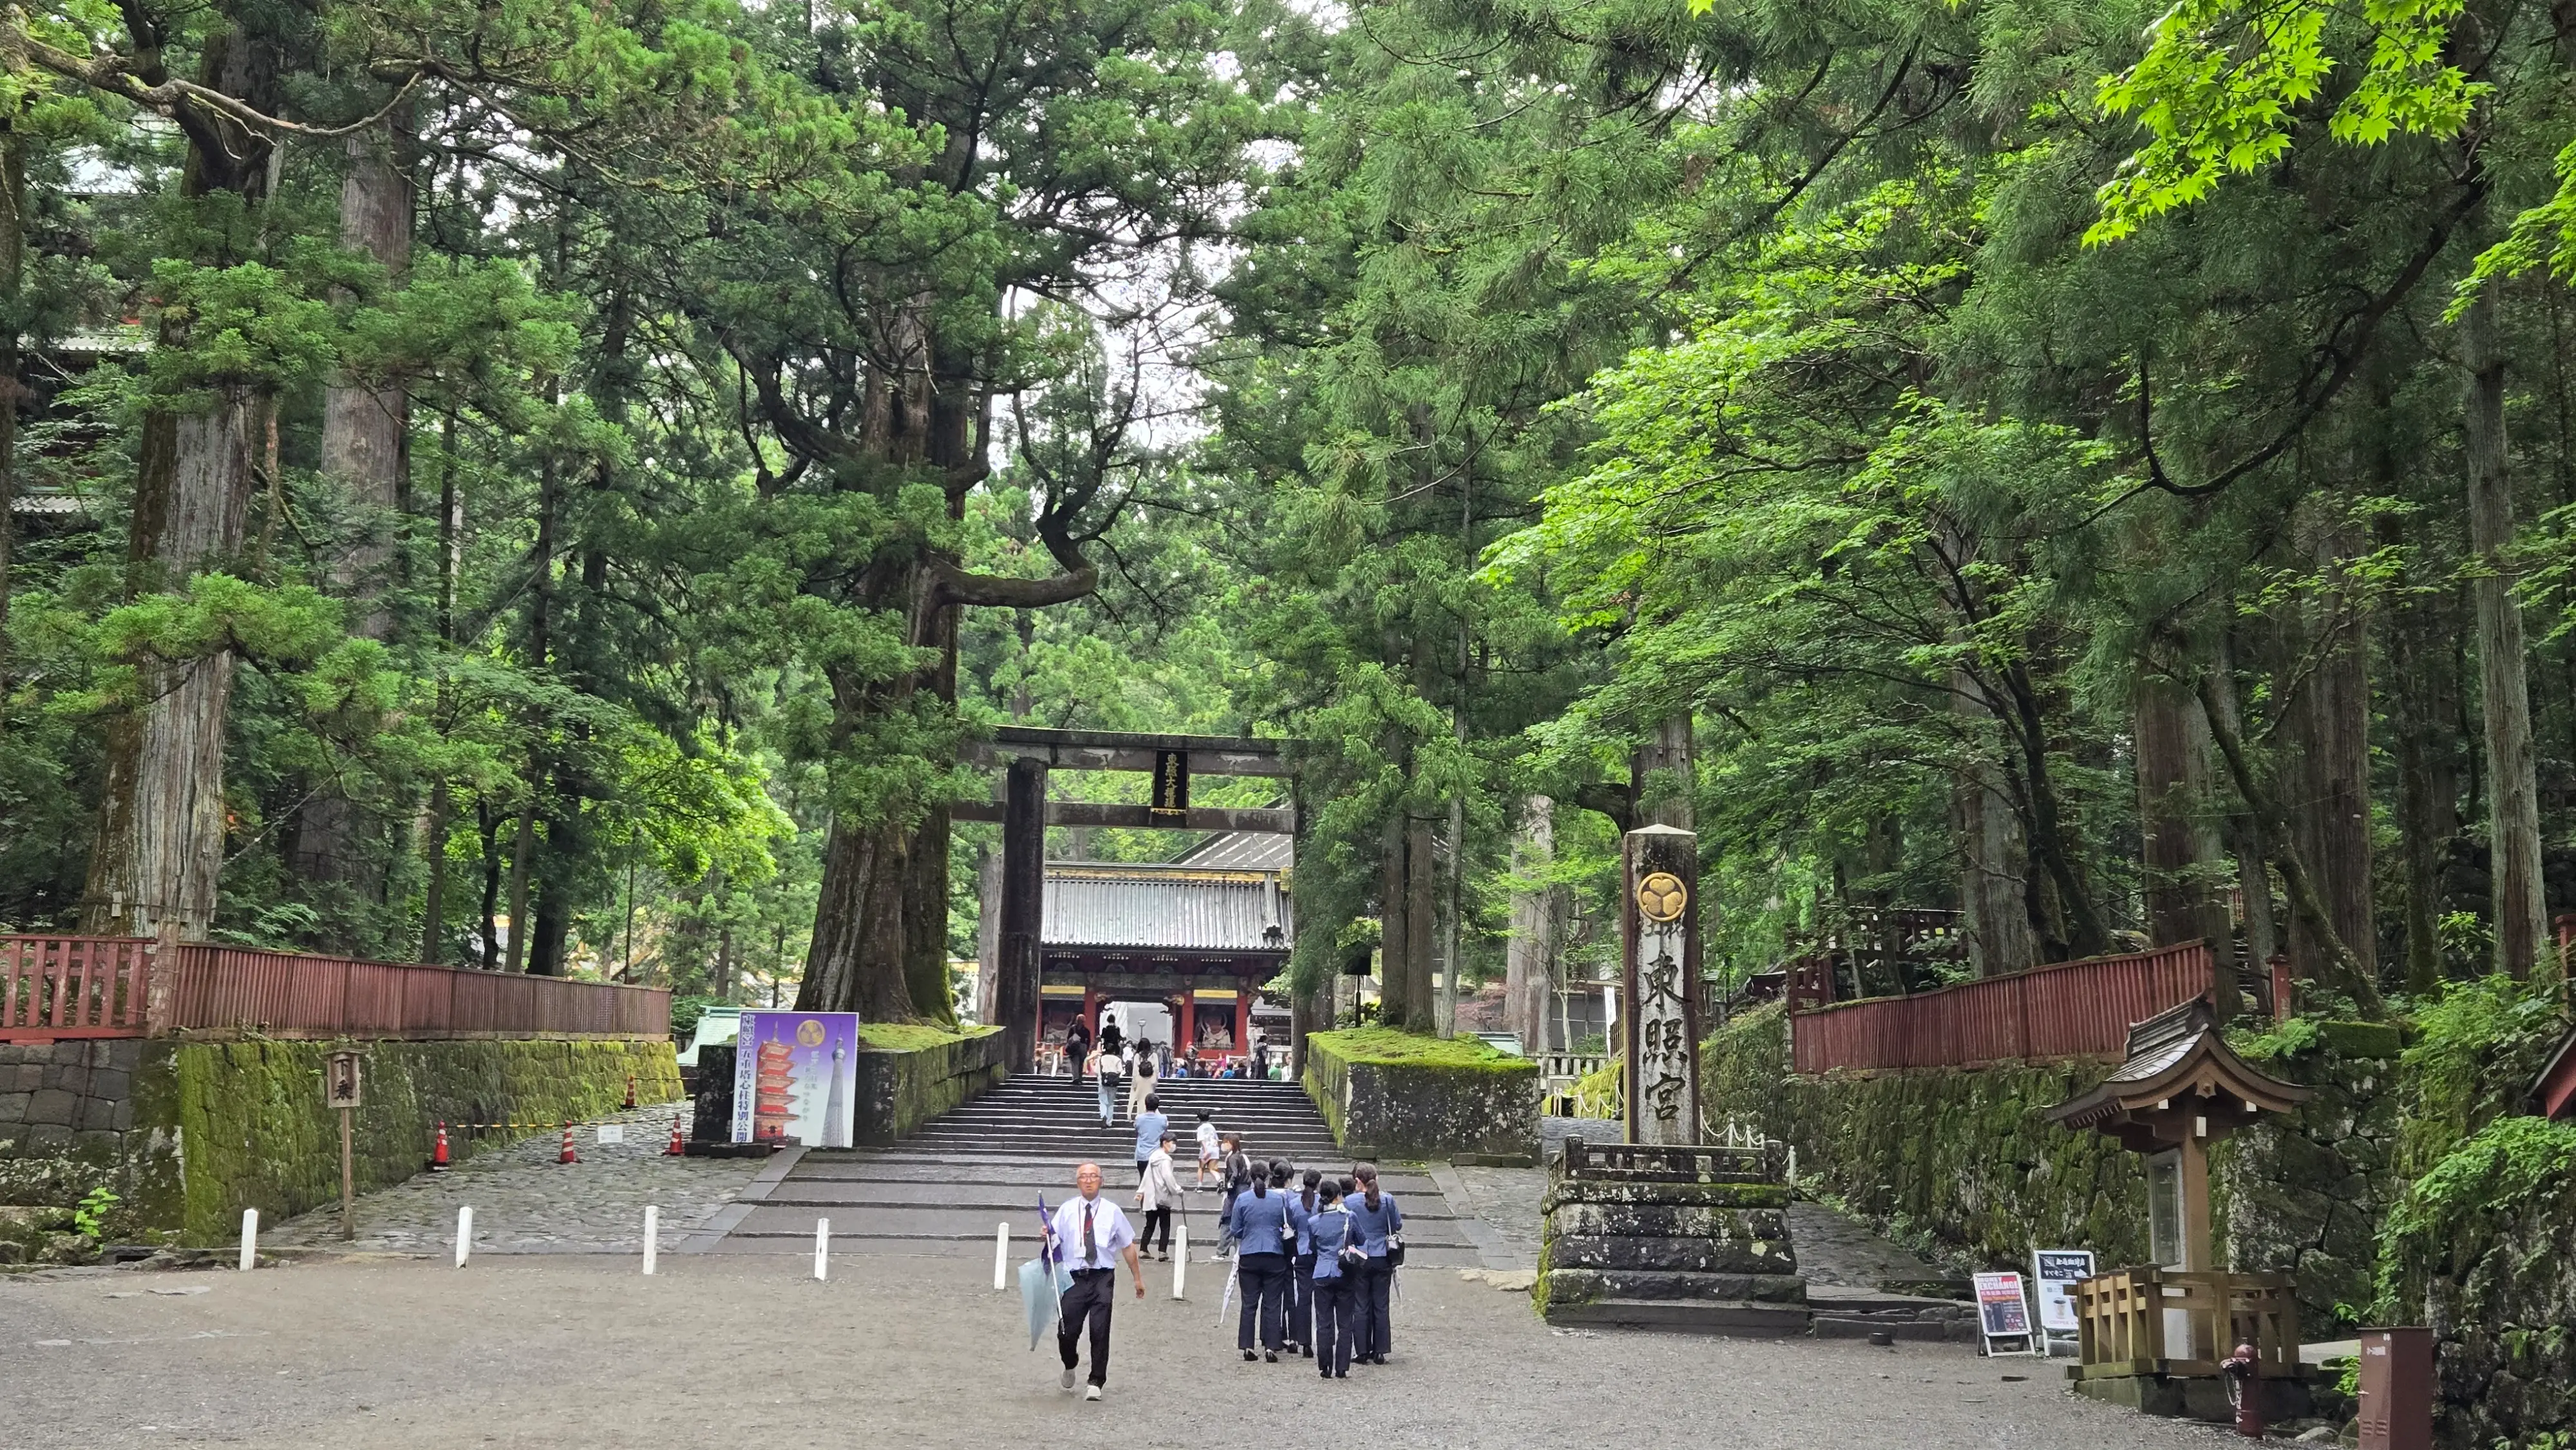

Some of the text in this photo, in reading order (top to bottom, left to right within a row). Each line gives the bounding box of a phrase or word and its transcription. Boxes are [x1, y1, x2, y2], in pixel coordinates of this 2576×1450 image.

[1643, 950, 1692, 1122] 東照宮
[1980, 1281, 2018, 1290] EXCHANGE
